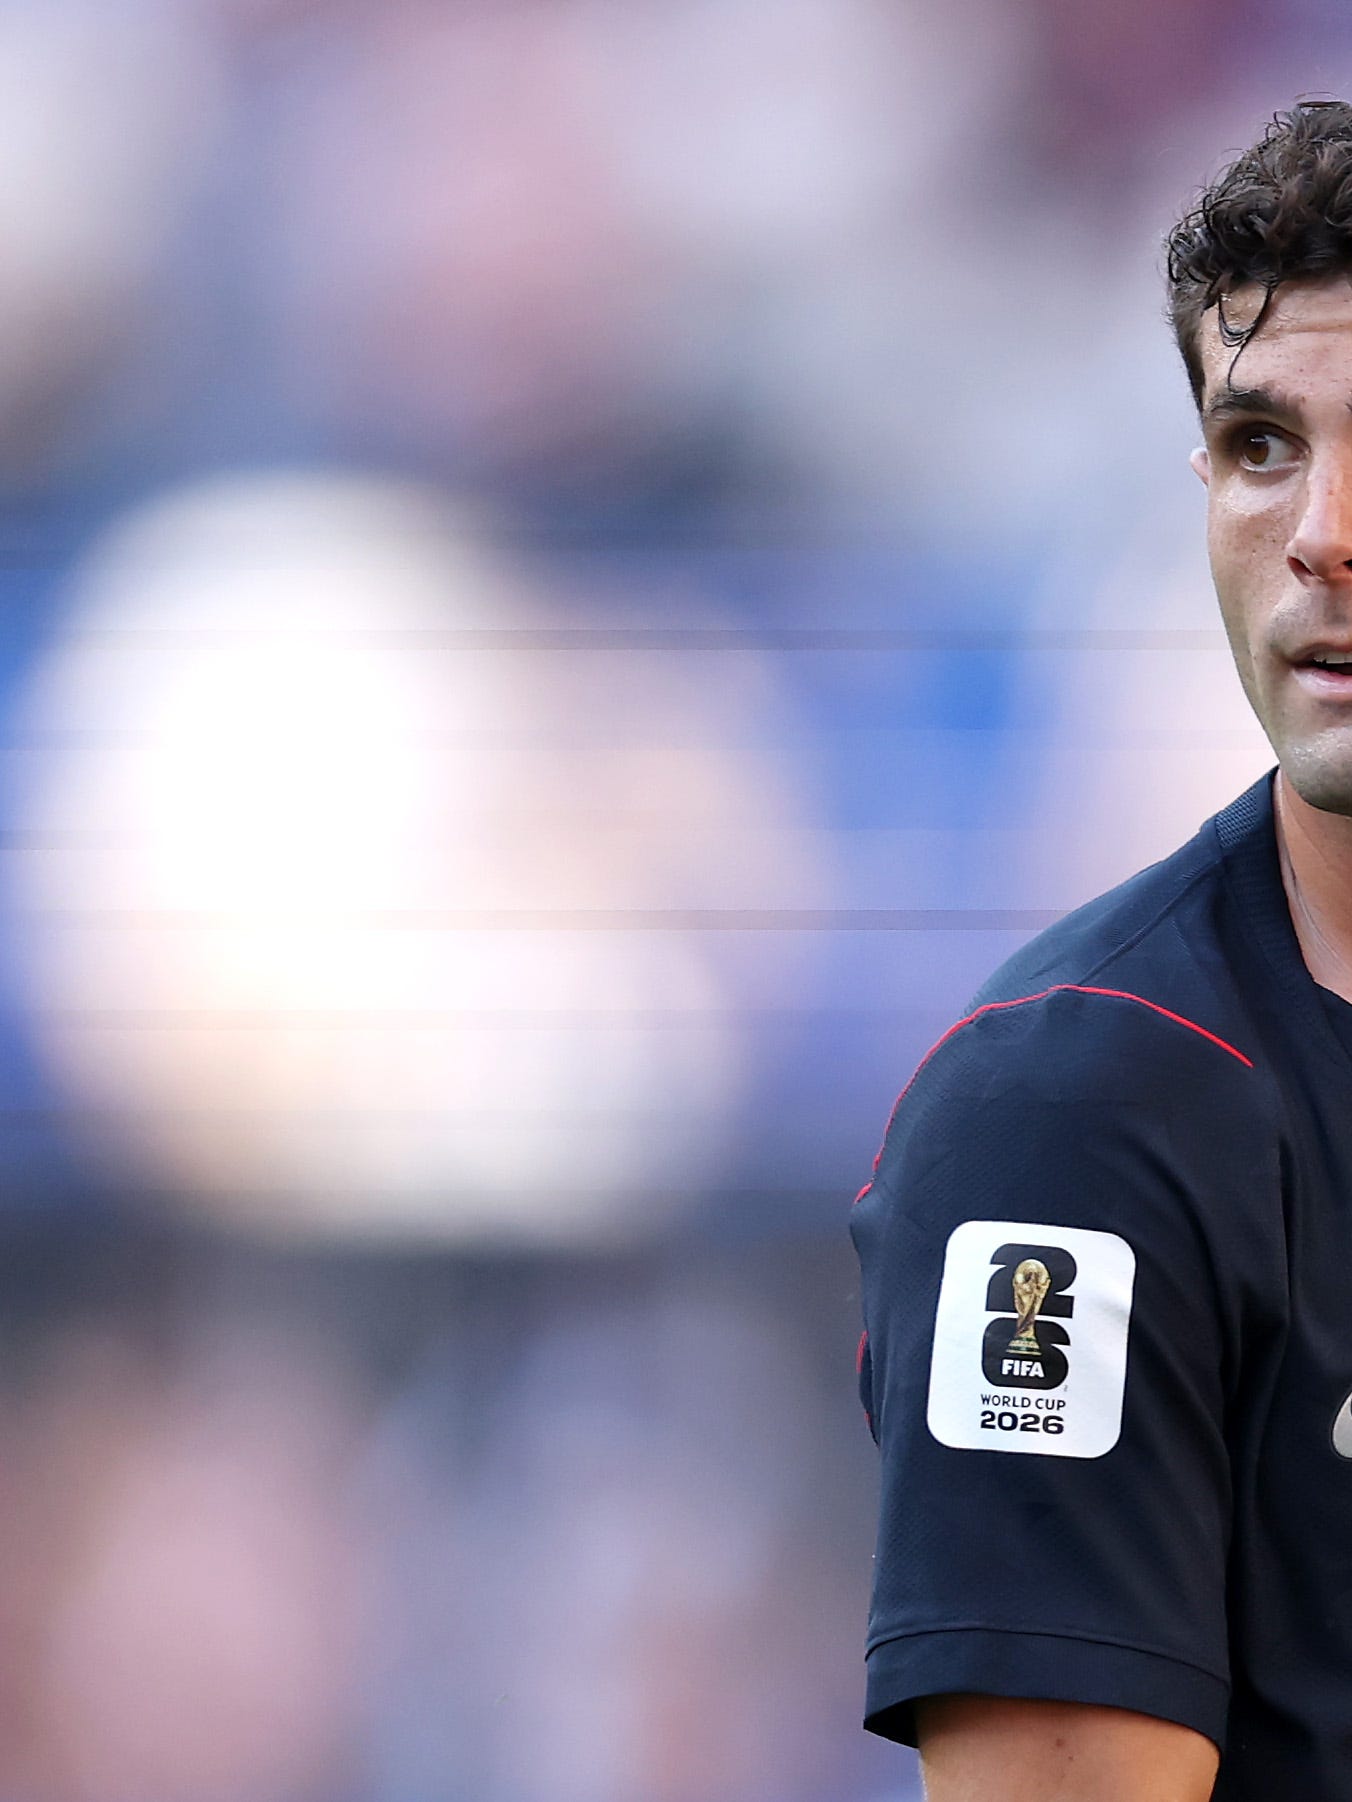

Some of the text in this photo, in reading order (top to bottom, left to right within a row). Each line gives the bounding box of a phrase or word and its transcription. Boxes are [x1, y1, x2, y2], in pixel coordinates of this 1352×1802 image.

[1001, 1359, 1045, 1378] FIFA
[981, 1394, 1066, 1411] WORLD CUP
[980, 1410, 1064, 1434] 2026
